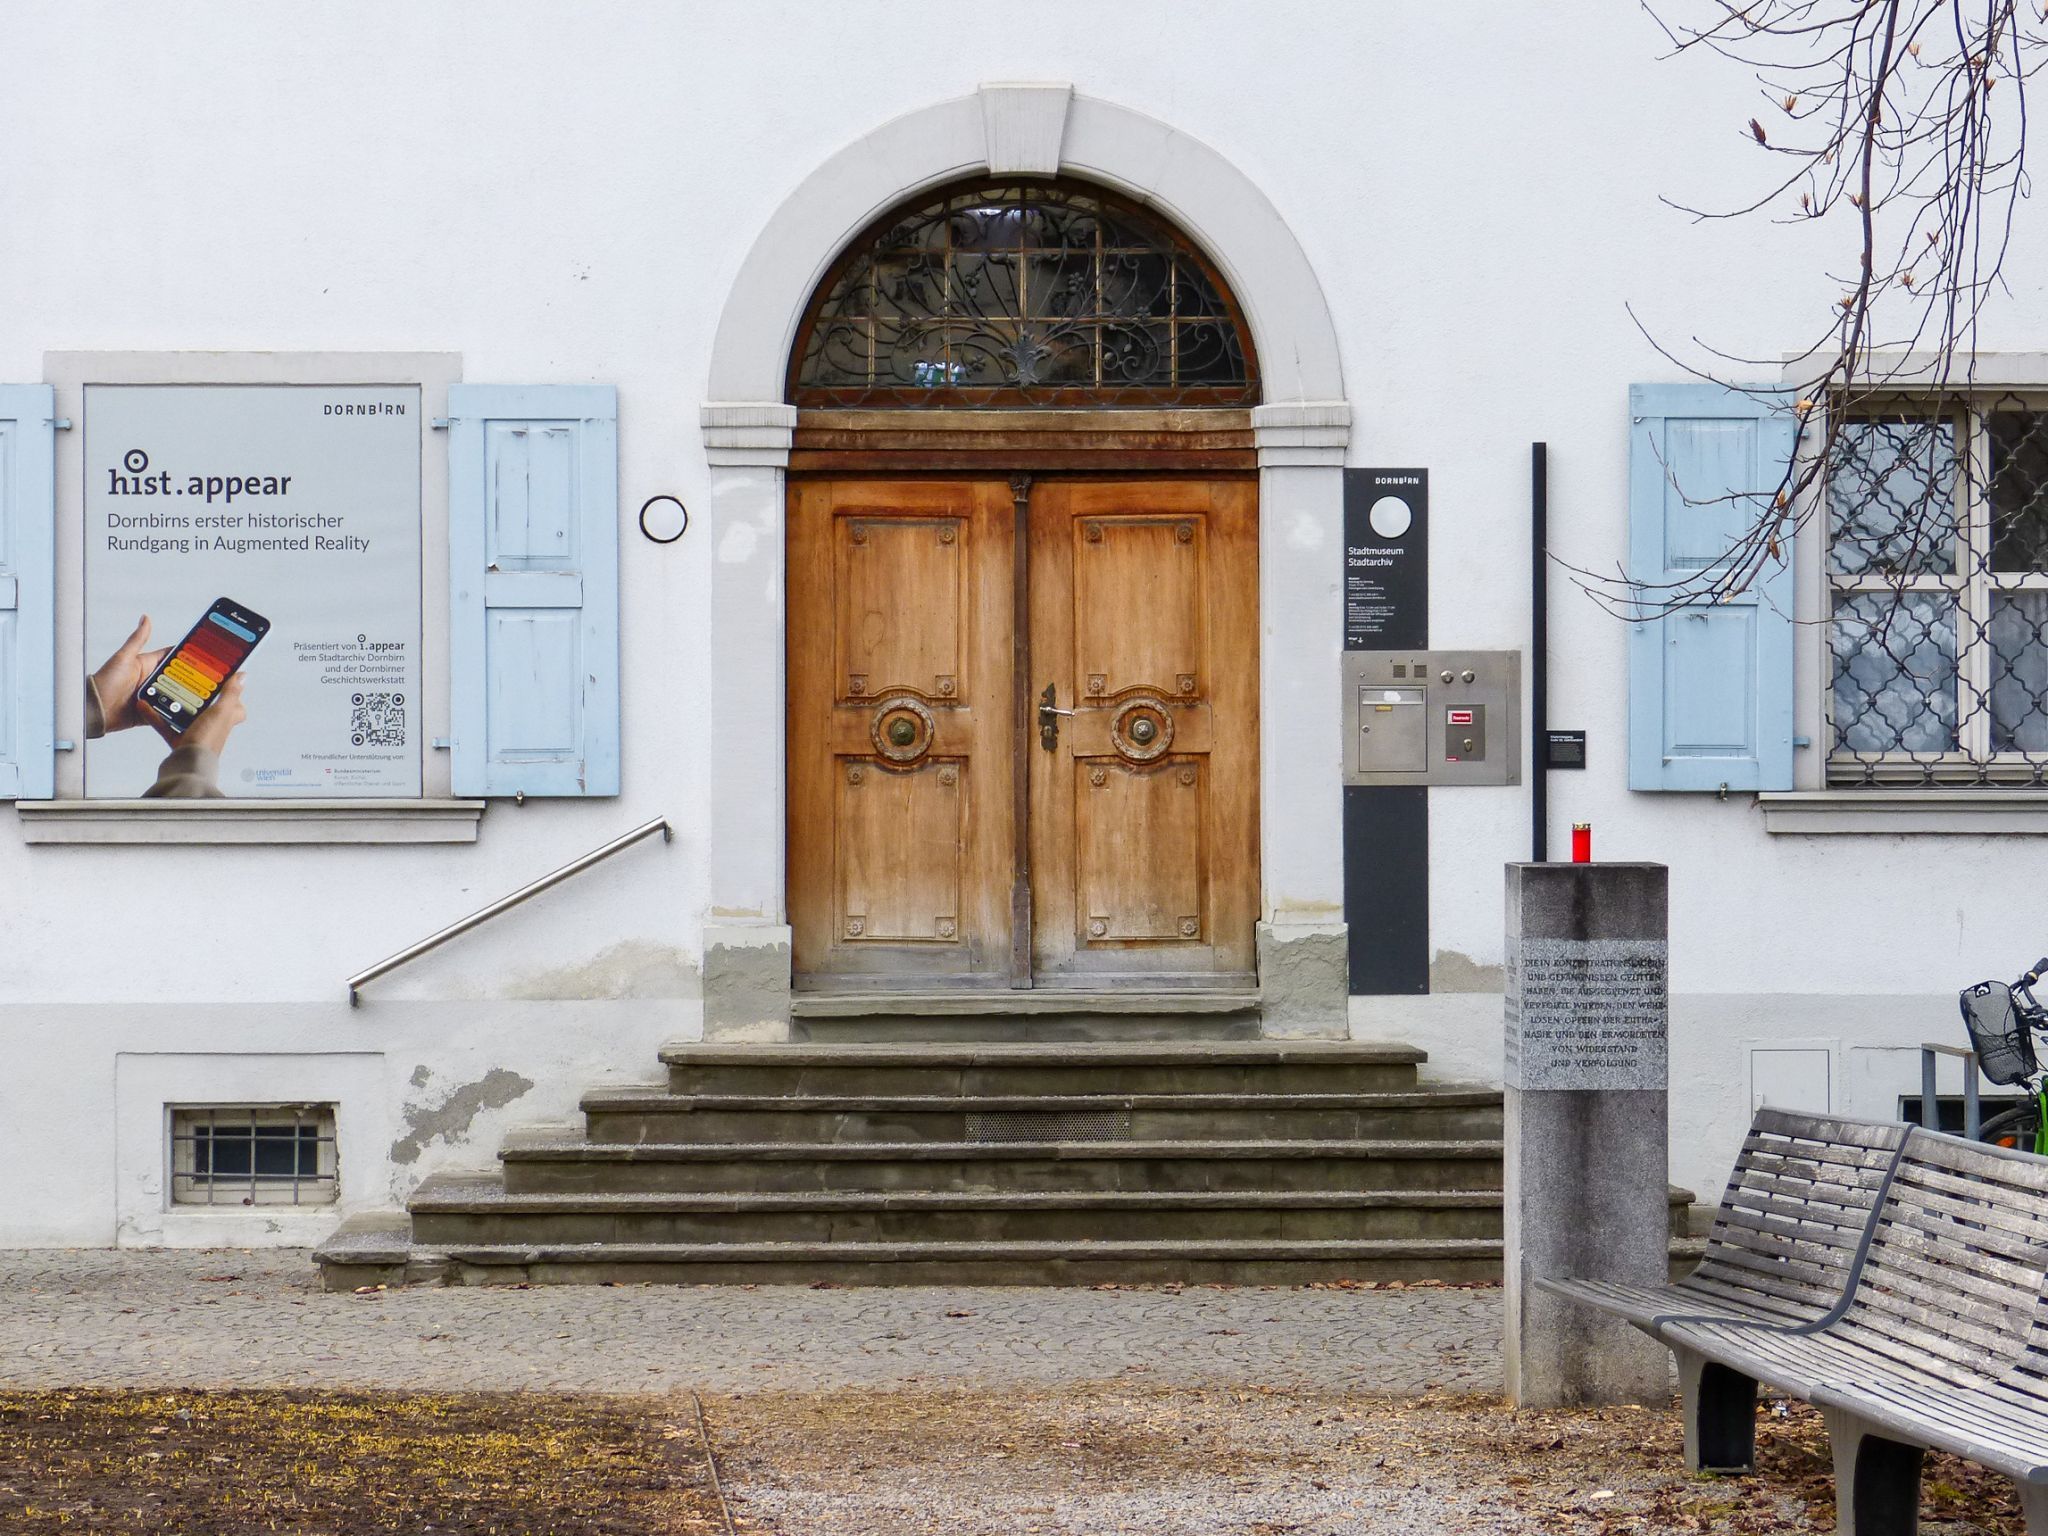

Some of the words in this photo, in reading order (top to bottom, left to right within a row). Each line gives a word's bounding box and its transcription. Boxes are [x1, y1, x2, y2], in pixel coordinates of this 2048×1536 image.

[324, 402, 406, 416] DORNBIRN
[107, 449, 292, 504] hist.appear
[1375, 476, 1419, 484] DORNBIRN
[107, 513, 190, 529] Dornbirns
[195, 515, 243, 529] erster
[247, 513, 344, 529] historischer
[107, 535, 189, 553] Rundgang
[195, 535, 209, 551] in
[214, 535, 309, 553] Augmented
[315, 535, 370, 553] Reality
[1348, 547, 1404, 555] Stadtmuseum
[1348, 558, 1393, 566] Stadtarchiv
[293, 642, 339, 651] Präsentiert
[357, 633, 405, 653] i.appear
[298, 653, 317, 662] dem
[319, 653, 365, 662] Stadtarchiv
[367, 653, 405, 662] Dornbirn
[325, 665, 341, 673] und
[343, 665, 357, 673] der
[359, 665, 405, 673] Dornbirner
[320, 675, 405, 684] Geschichtswerkstatt
[350, 753, 391, 762] Unterstützung
